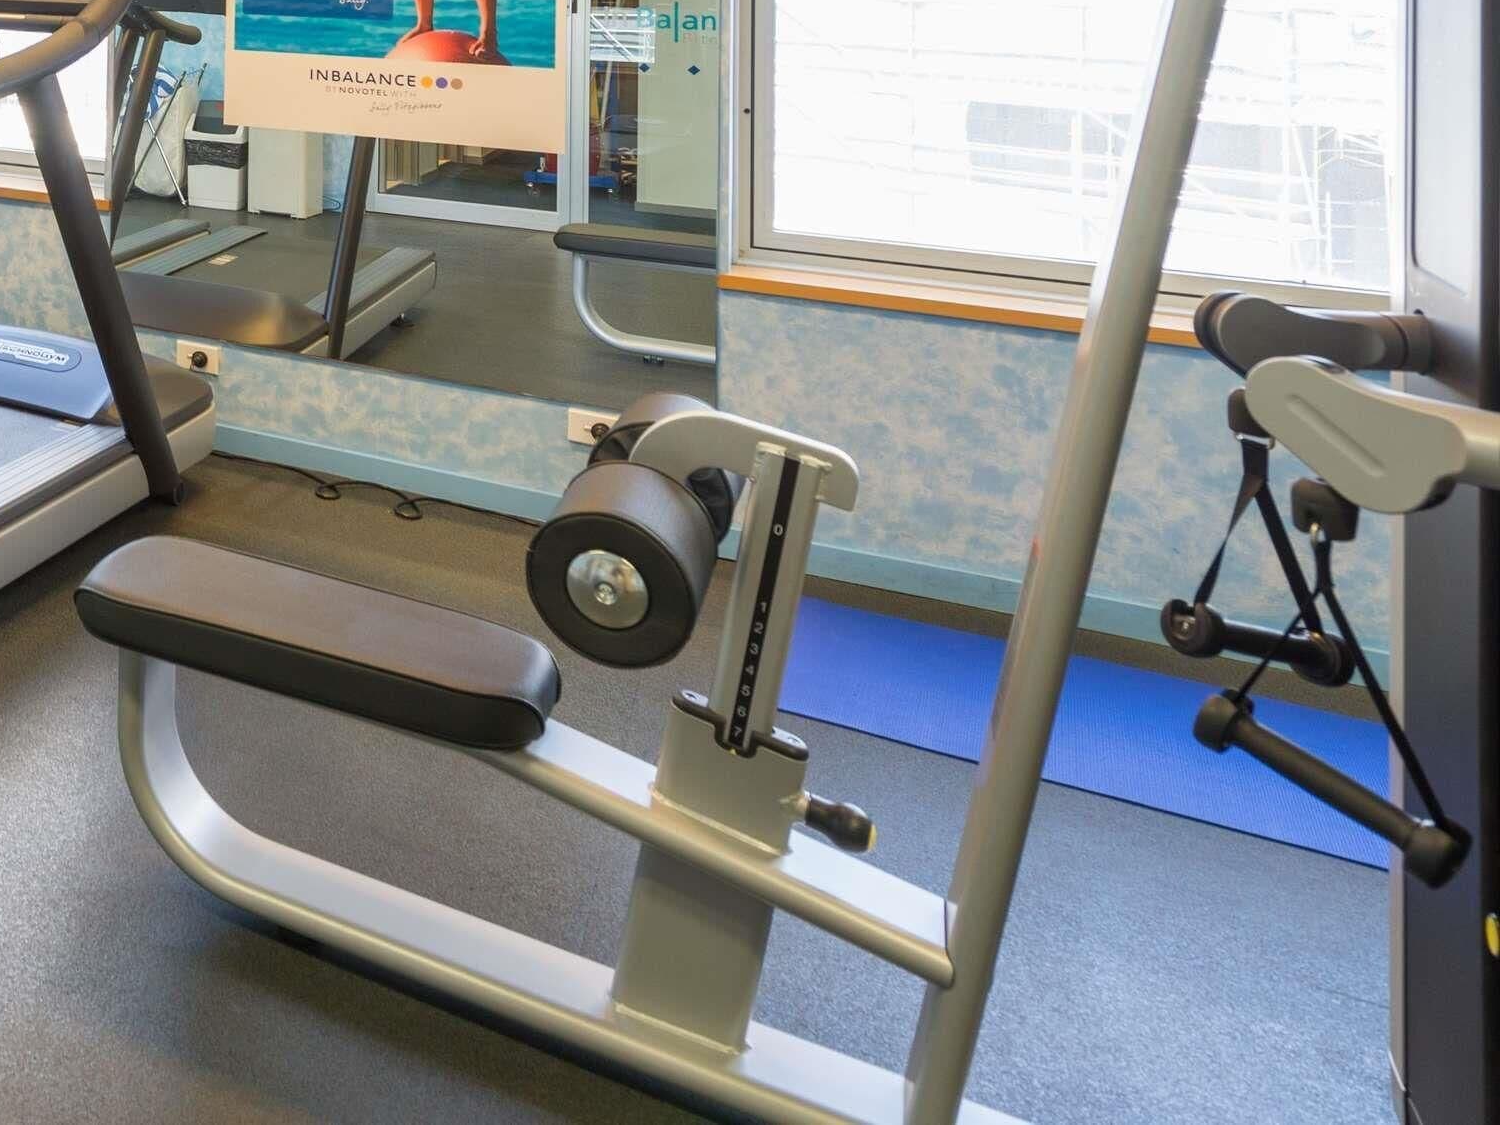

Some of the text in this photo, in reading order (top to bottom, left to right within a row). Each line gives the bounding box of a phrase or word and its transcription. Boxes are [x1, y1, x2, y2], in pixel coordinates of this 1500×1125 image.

[309, 69, 417, 87] INBALANCE
[338, 86, 388, 97] NOVOTEL
[773, 524, 784, 536] 0
[761, 602, 768, 614] 1
[754, 622, 764, 635] 2
[750, 642, 760, 655] 3
[740, 684, 751, 697] 5
[737, 705, 748, 717] 6
[734, 725, 743, 738] 7
